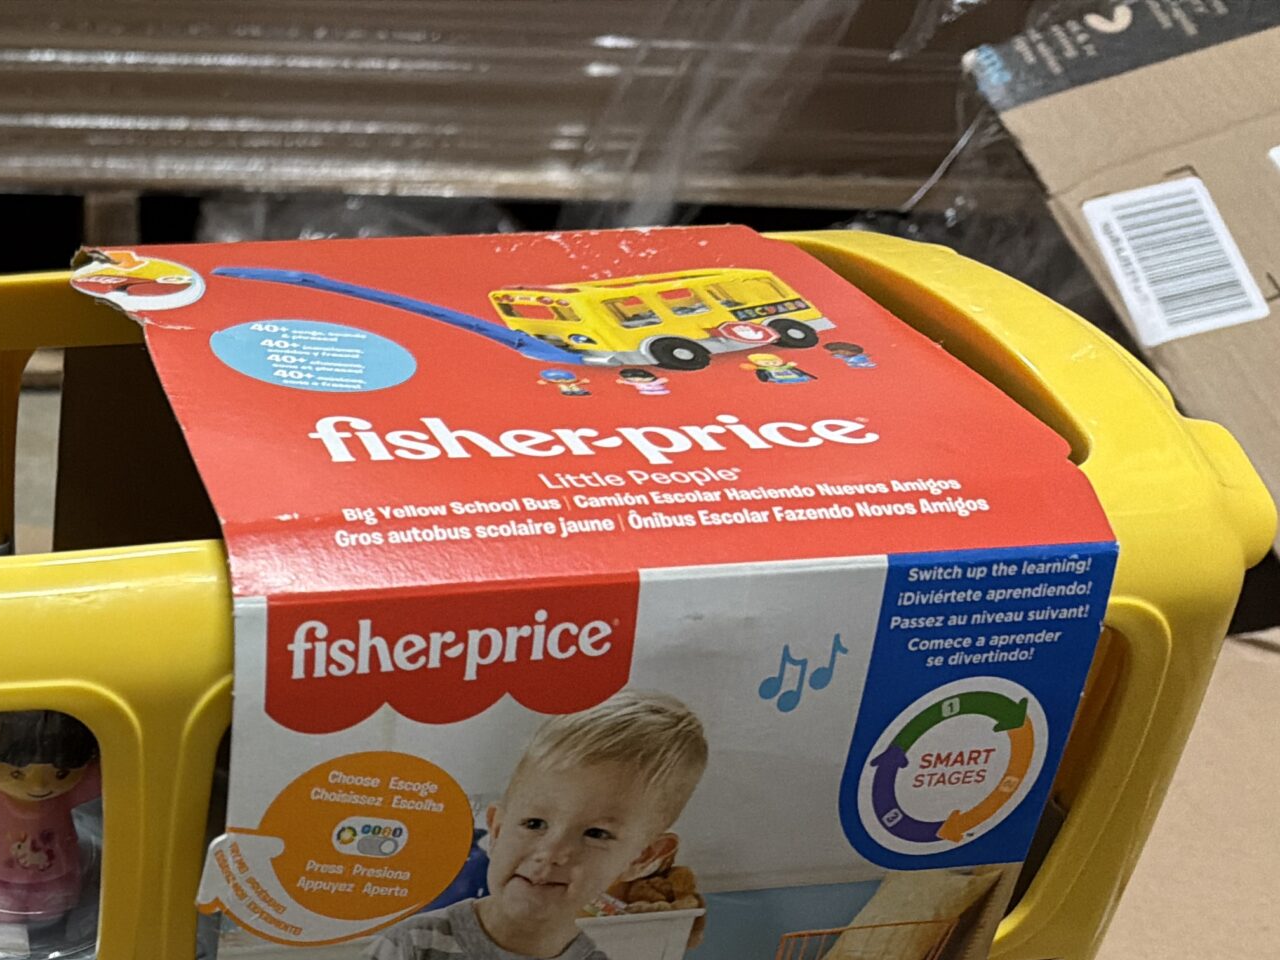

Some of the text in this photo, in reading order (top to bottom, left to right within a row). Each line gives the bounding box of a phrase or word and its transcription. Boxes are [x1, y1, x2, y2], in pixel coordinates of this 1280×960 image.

[249, 323, 288, 333] 40+
[260, 338, 300, 349] 40+
[267, 353, 307, 364] 40+
[273, 369, 314, 379] 40+
[308, 414, 880, 465] fisher-price
[537, 468, 738, 489] Little People
[342, 477, 962, 525] Big Yellow School Bus Camión Escolar Haciendo Nuevos Amigos
[334, 496, 990, 548] Gros autobus scolaire jaune Ônibus Escolar Fazendo Novos Amigos
[908, 557, 1092, 582] Switch up the learning!
[897, 581, 1093, 606] ¡Diviértete aprendiendo!
[890, 604, 1090, 630] Passez au niveau suivant!
[287, 608, 614, 681] fisher-price
[908, 629, 1062, 651] Comece a aprender
[926, 647, 1035, 667] se divertindo!
[919, 748, 996, 769] SMART
[328, 770, 438, 797] Choose Escoge
[912, 769, 986, 788] STAGES
[310, 787, 444, 812] Choisissez Escolha
[306, 860, 344, 874] Press
[296, 876, 355, 894] Appuyez
